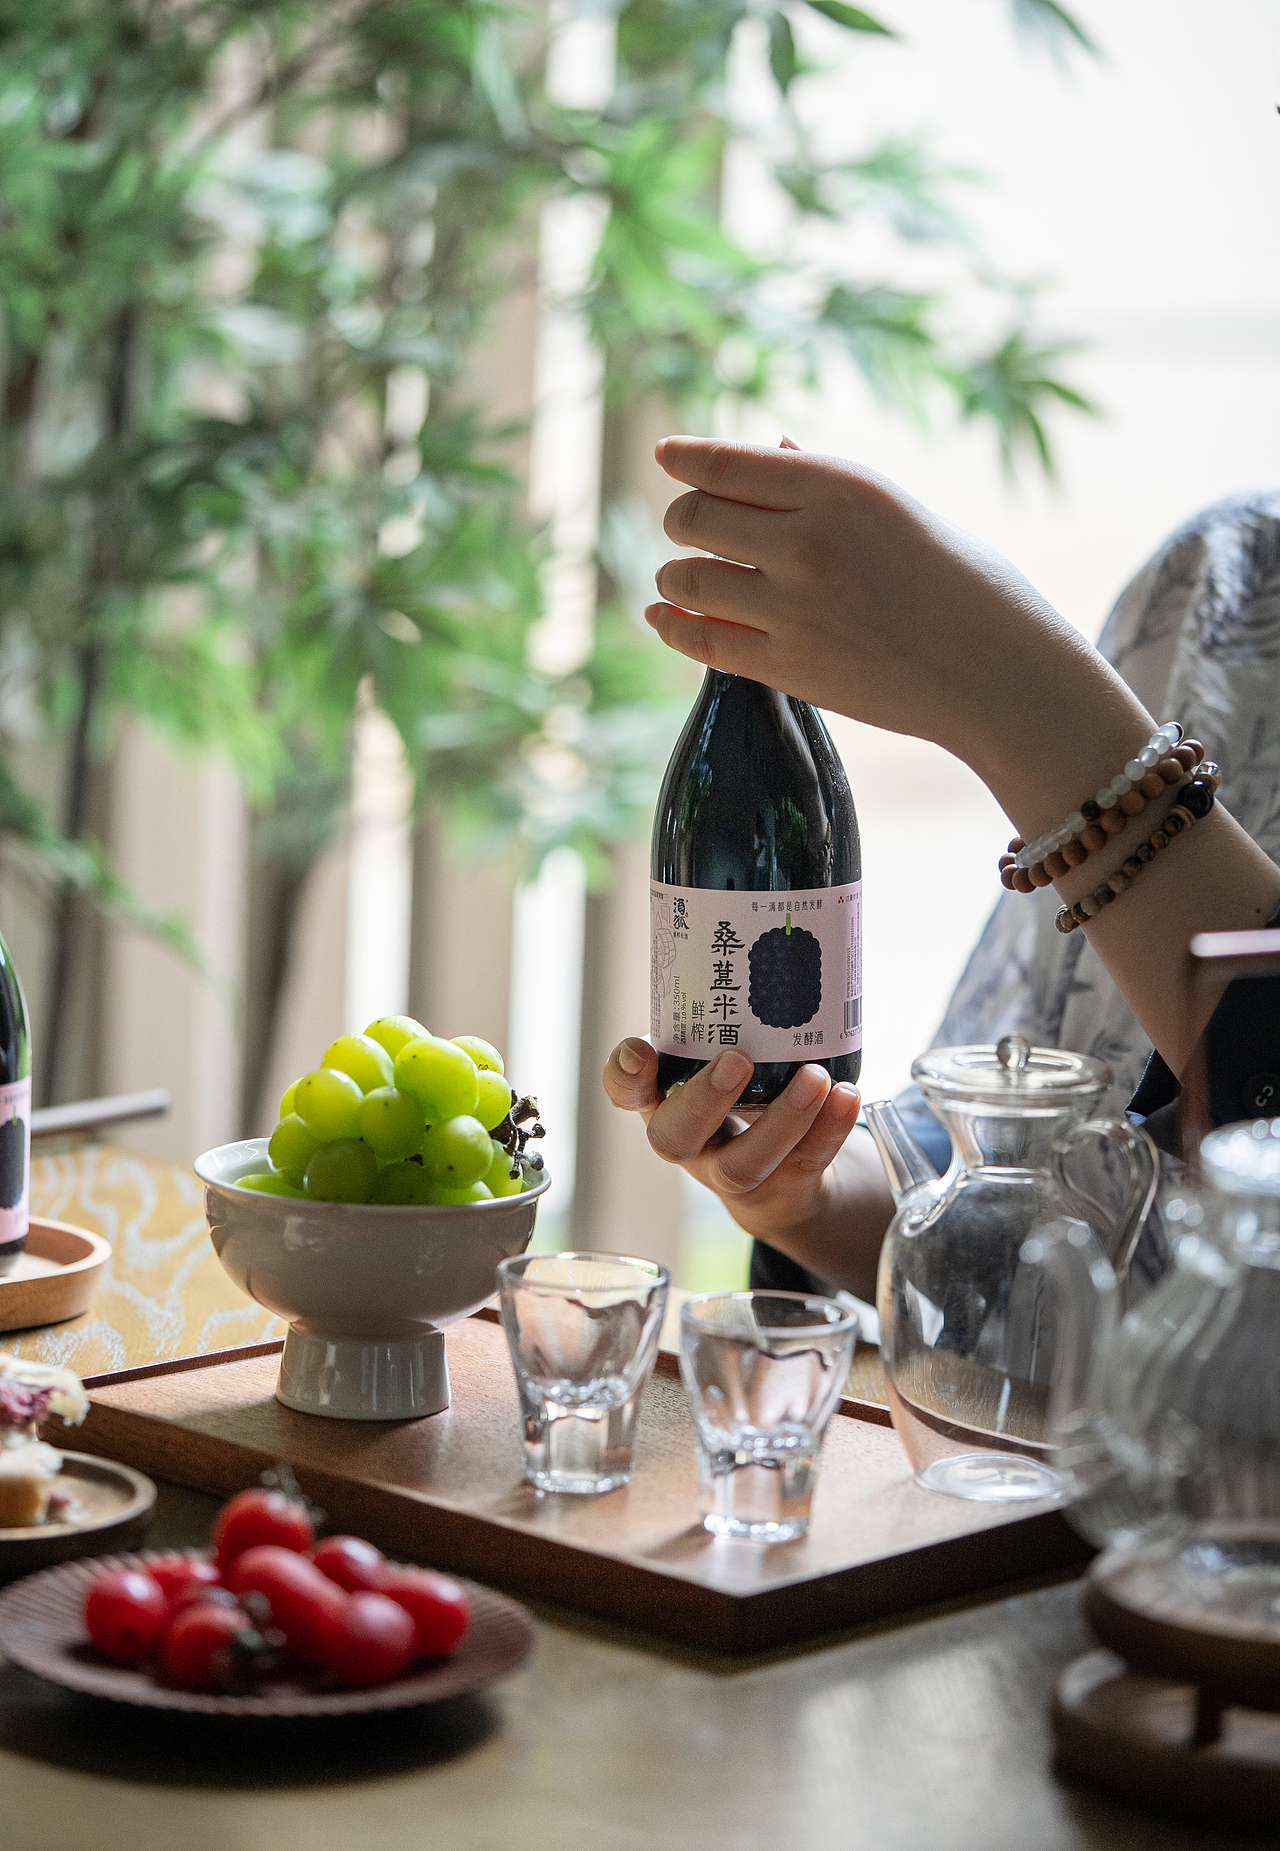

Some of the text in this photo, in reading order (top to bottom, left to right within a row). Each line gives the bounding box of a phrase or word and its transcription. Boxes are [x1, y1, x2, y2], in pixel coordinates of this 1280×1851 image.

[752, 899, 822, 913] 每一滴都是自然发酵
[708, 920, 746, 1046] 桑葚米酒
[690, 1000, 705, 1043] 鲜榨
[792, 1031, 824, 1047] 发酵酒
